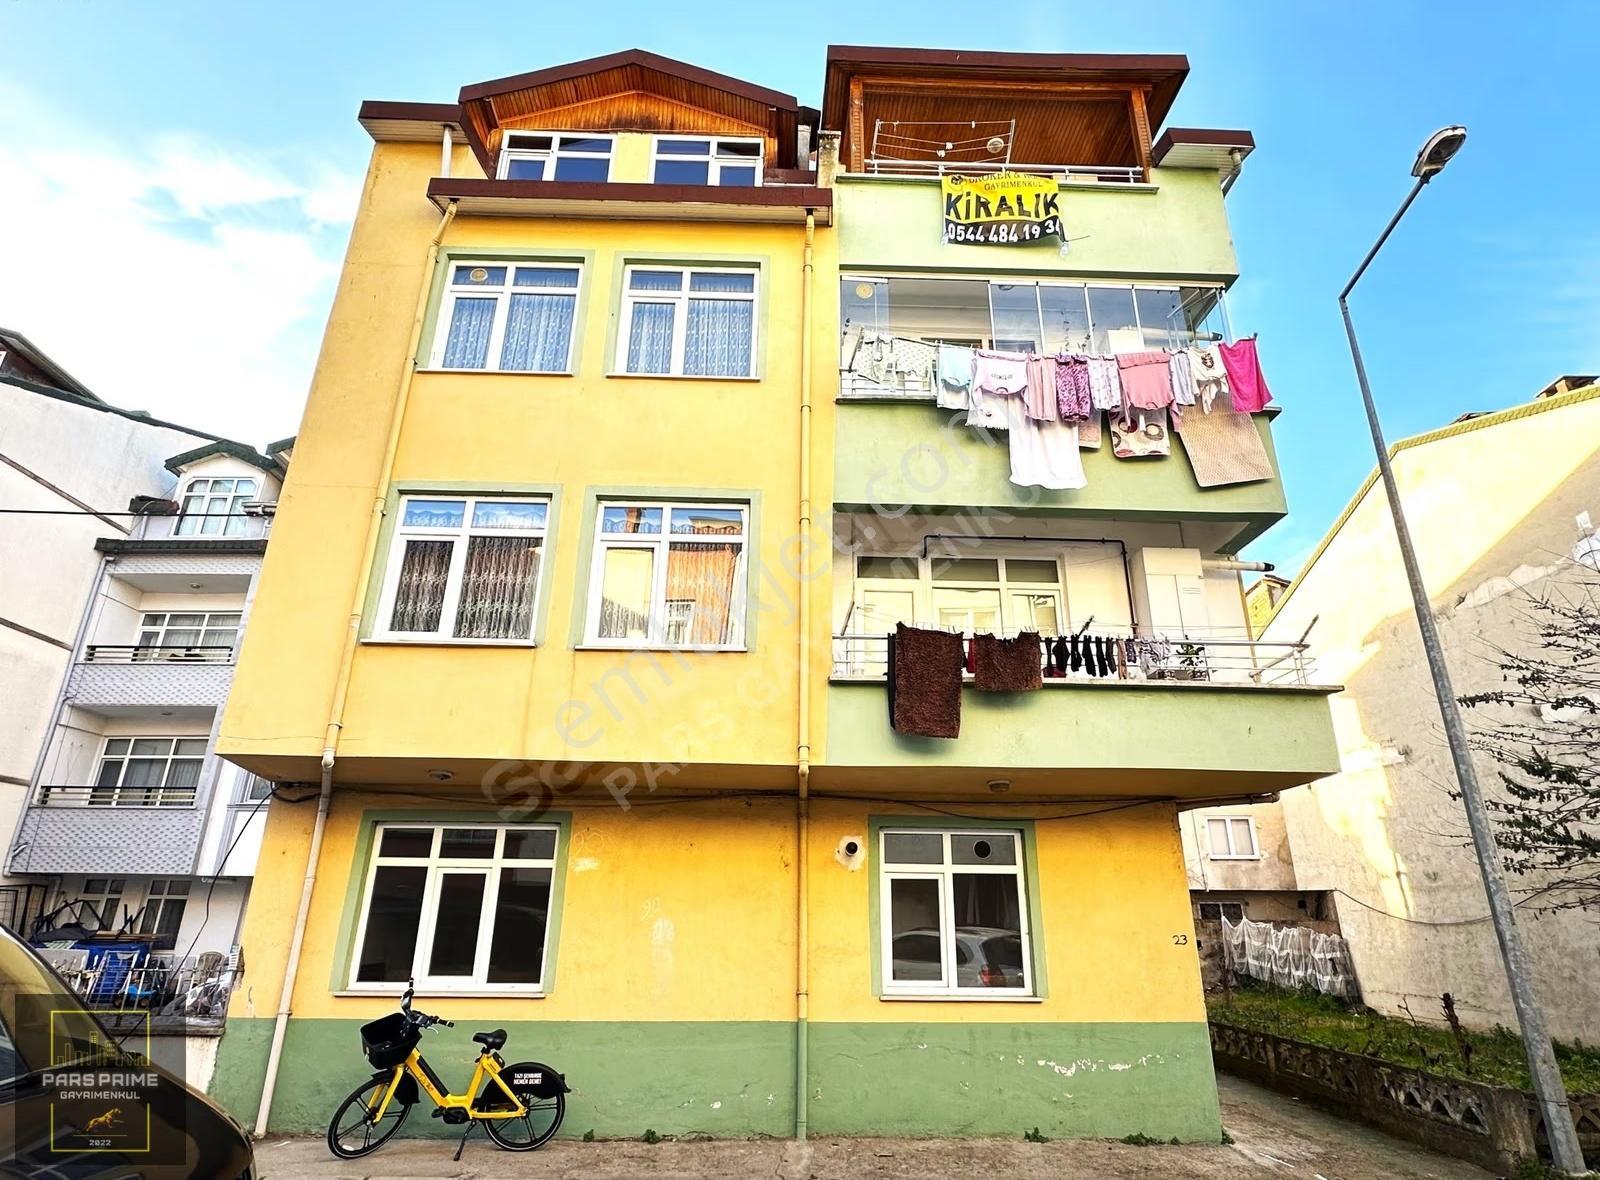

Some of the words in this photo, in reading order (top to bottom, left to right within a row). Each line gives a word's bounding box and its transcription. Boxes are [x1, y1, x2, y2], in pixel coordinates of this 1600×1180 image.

[948, 223, 985, 242] 0544
[988, 223, 1019, 243] 484
[1023, 224, 1041, 240] 19
[1172, 934, 1188, 945] 23
